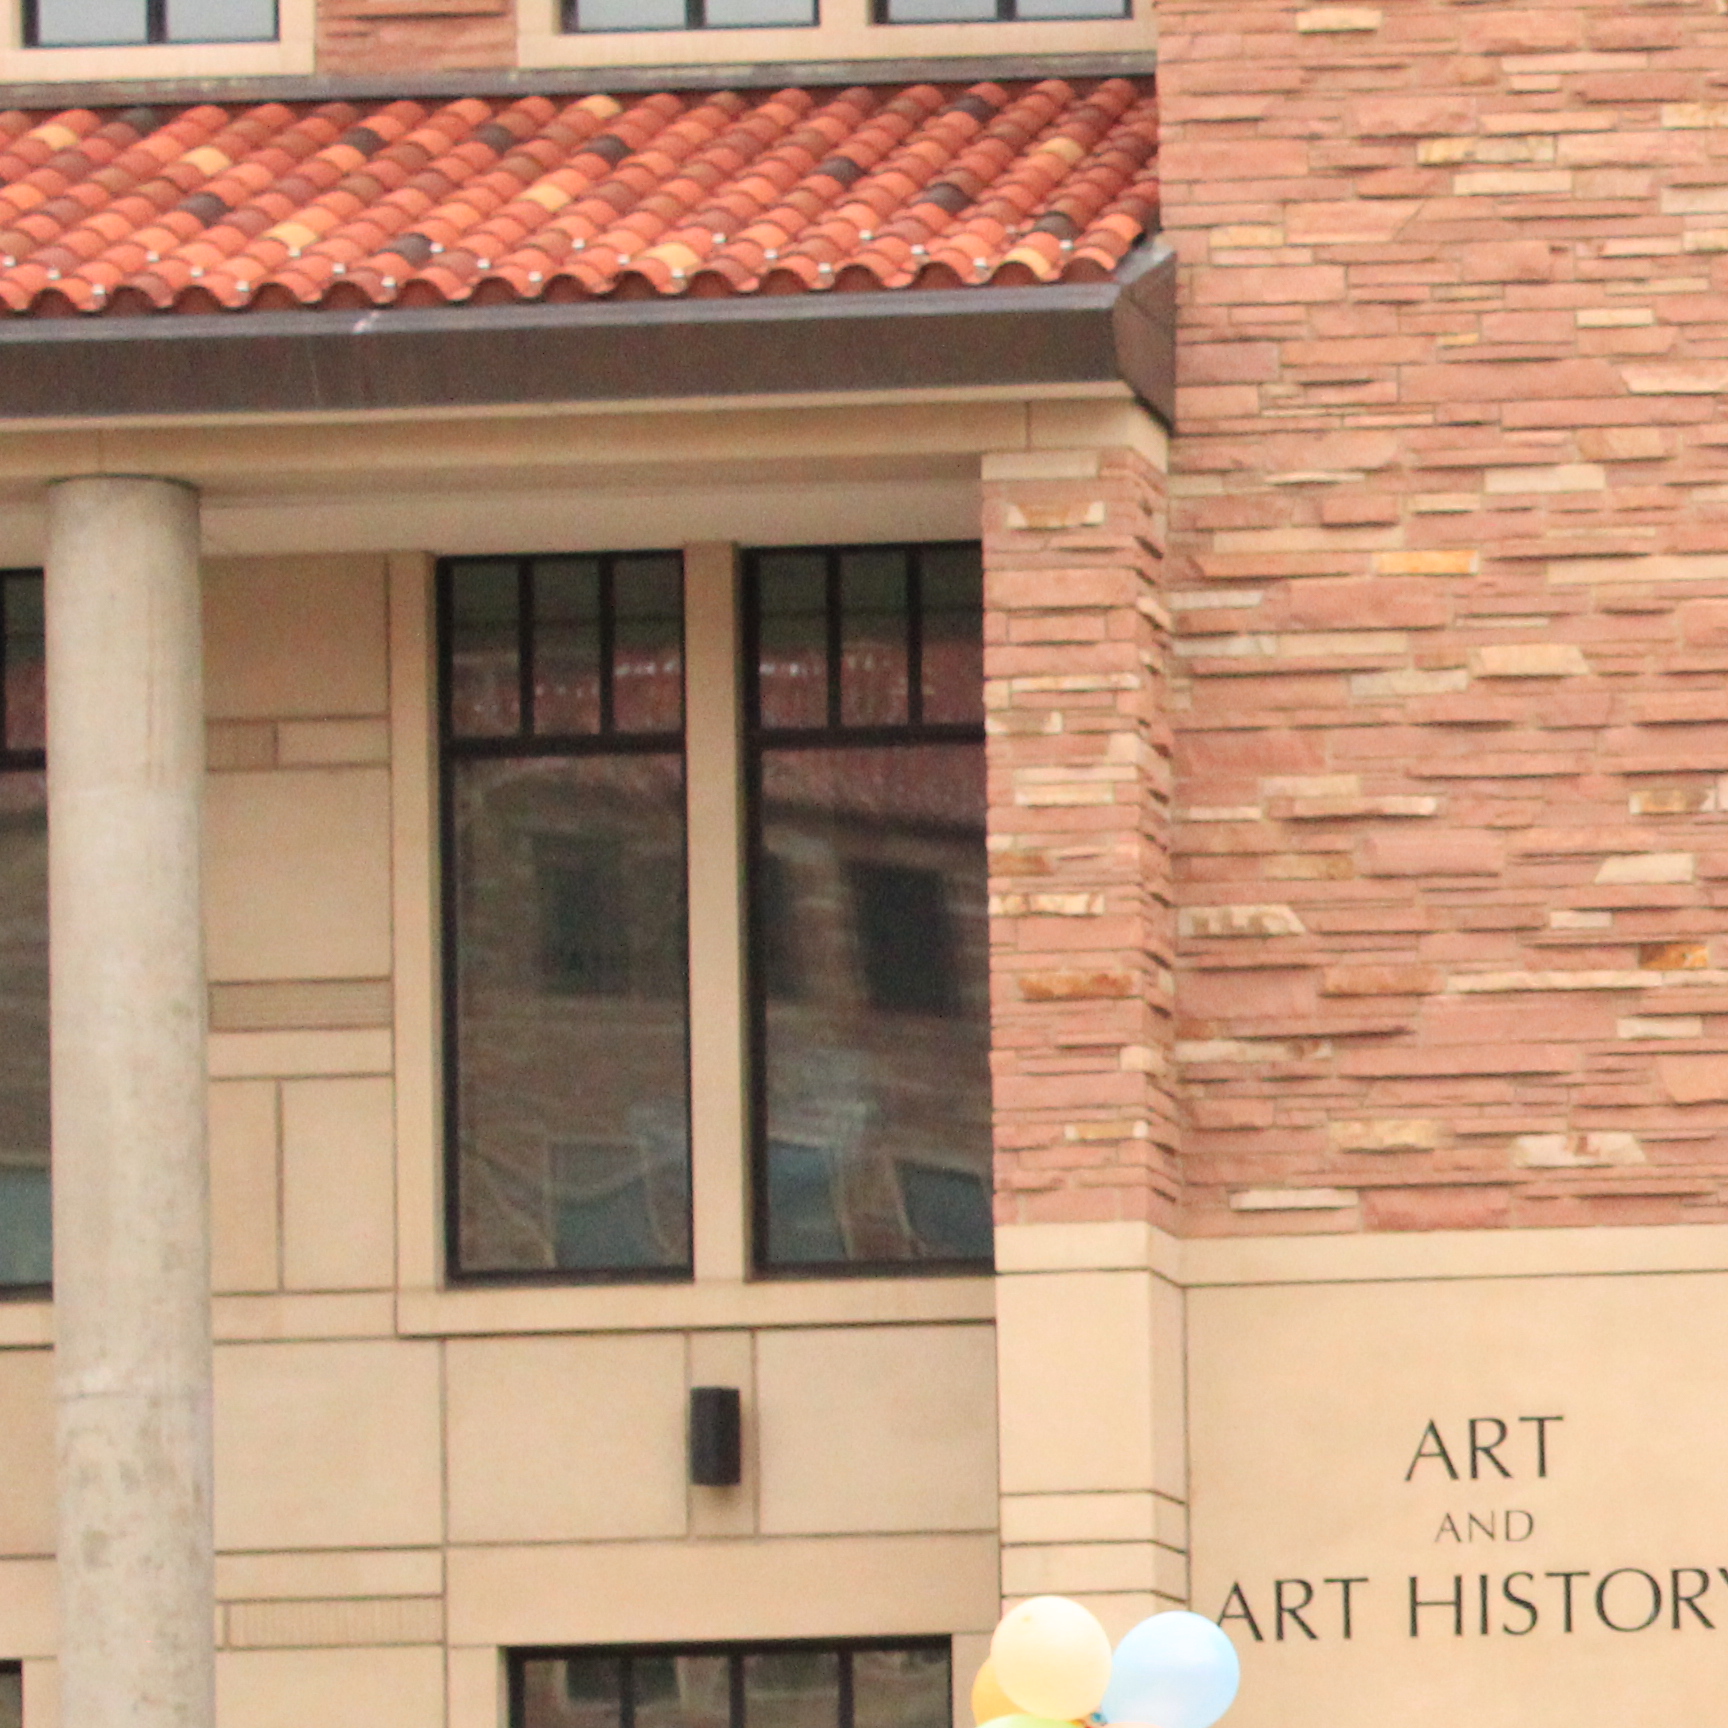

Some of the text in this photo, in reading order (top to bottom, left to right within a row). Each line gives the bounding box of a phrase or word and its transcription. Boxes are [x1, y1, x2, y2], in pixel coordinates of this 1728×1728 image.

[1404, 1416, 1565, 1481] ART
[1434, 1510, 1534, 1543] AND
[1217, 1577, 1369, 1642] ART
